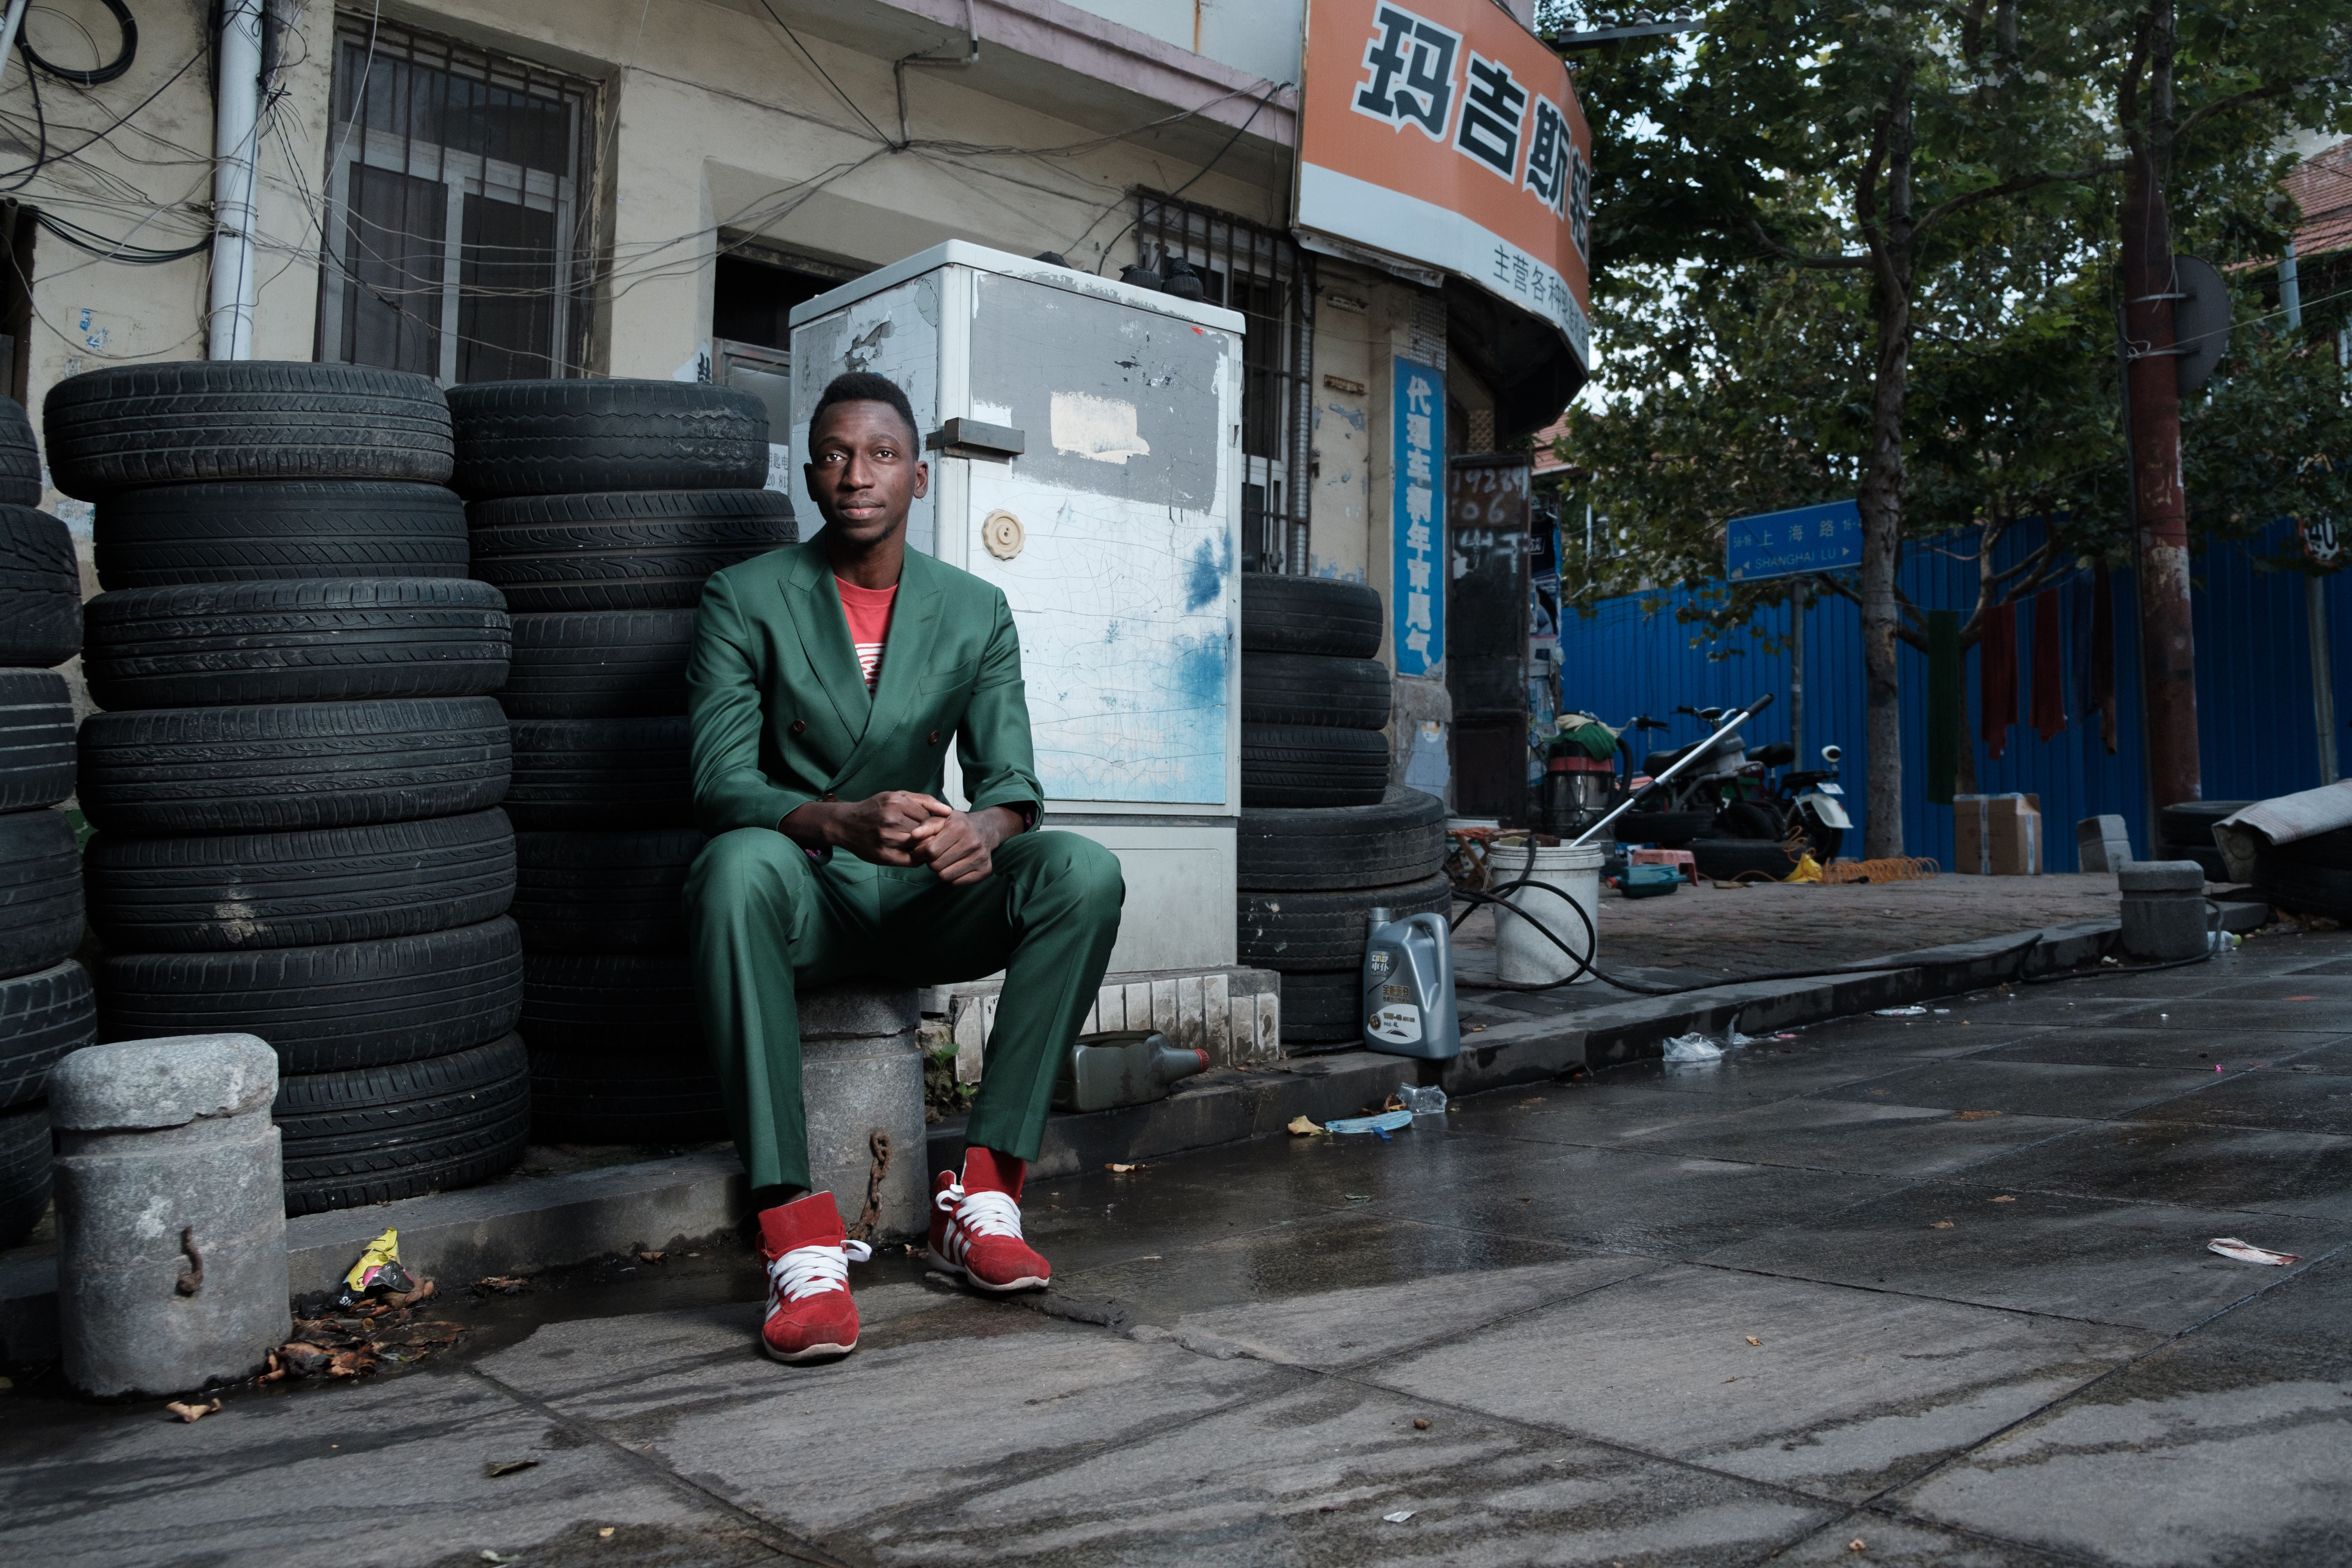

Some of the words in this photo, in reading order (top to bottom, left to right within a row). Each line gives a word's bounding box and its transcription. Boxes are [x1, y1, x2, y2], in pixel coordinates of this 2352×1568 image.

[1355, 4, 1588, 259] 玛吉斯轮
[779, 474, 788, 488] 81
[1758, 520, 1835, 546] 上海路
[1755, 552, 1814, 569] SHANGHAI
[1821, 548, 1836, 560] LU
